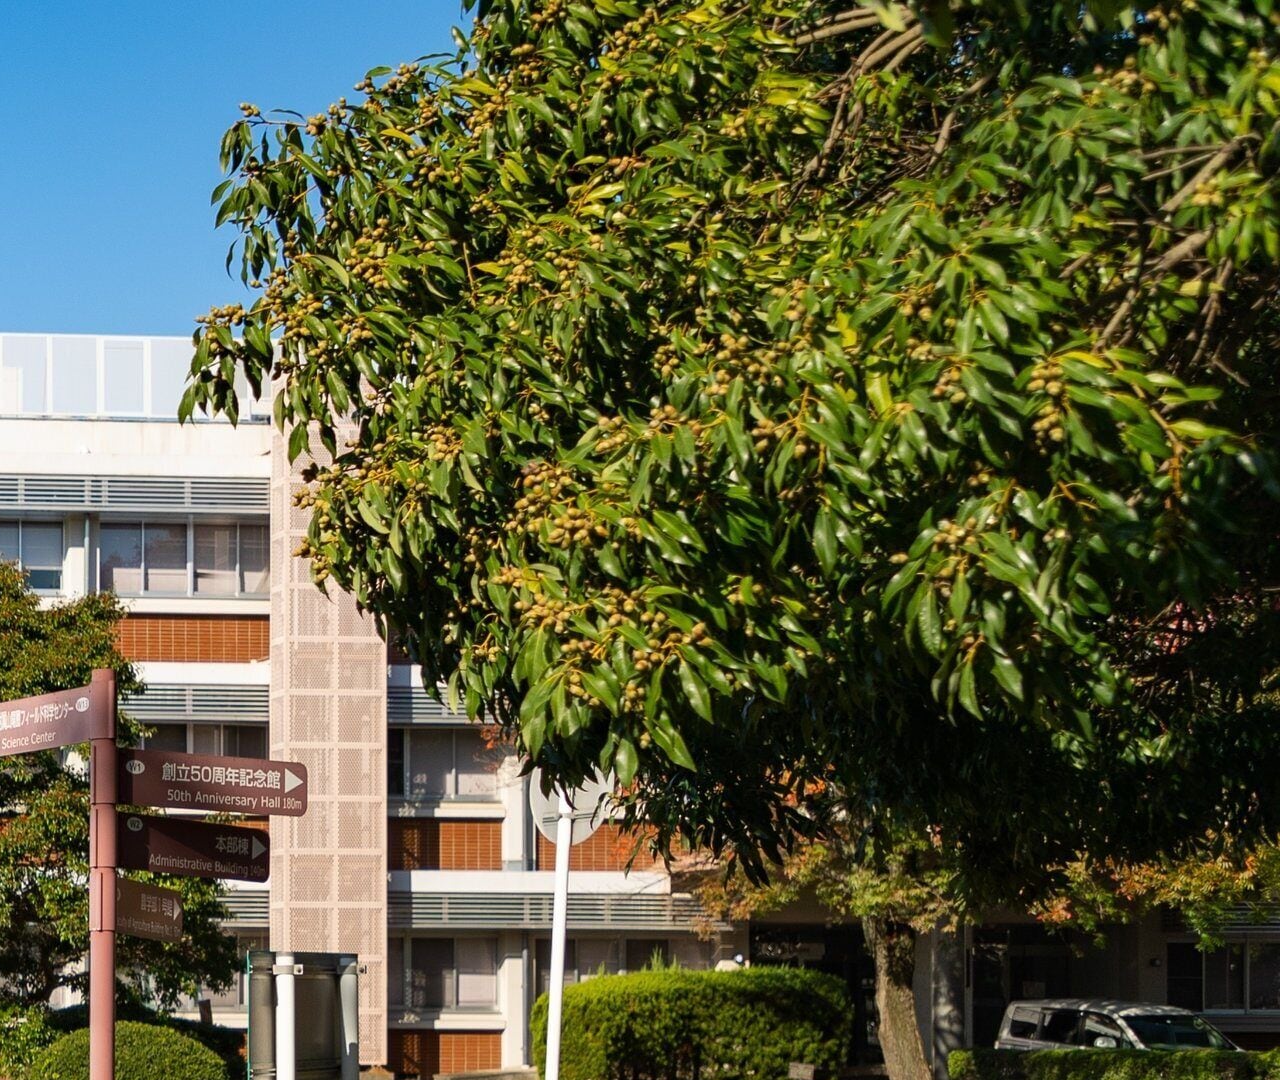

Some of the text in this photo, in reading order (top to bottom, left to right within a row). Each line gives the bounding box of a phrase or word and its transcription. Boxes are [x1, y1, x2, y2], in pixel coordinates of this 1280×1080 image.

[2, 735, 28, 750] Science
[31, 731, 56, 745] Center
[162, 762, 281, 790] 創立50周年記念館
[167, 789, 303, 810] 50th Anniversary Hall 180m
[215, 836, 249, 856] 本部棟
[149, 853, 213, 872] Administrative
[215, 861, 249, 878] Building
